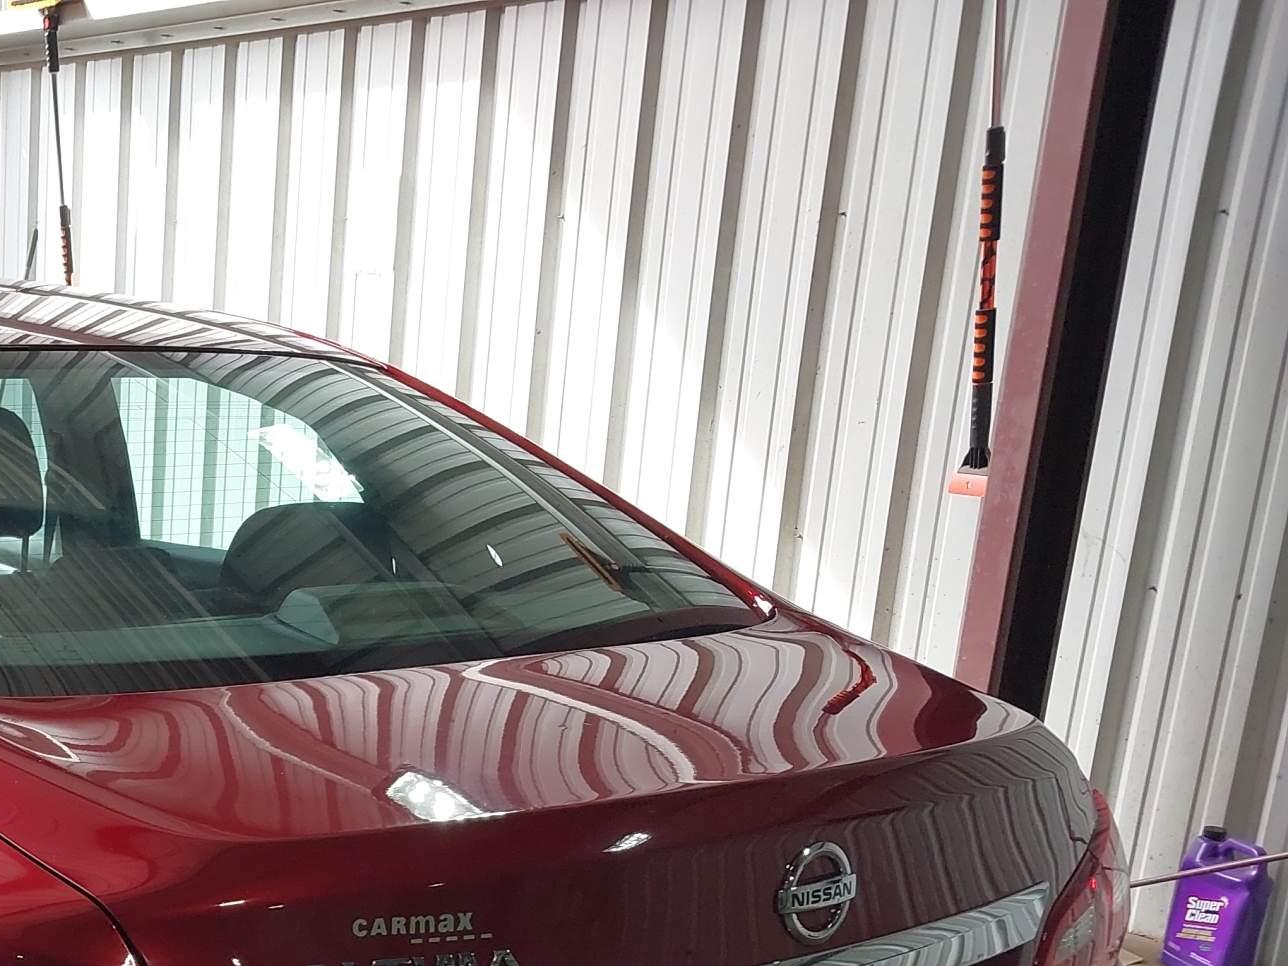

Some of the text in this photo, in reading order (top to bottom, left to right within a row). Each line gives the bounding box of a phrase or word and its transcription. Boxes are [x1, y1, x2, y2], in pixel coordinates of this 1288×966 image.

[791, 881, 852, 908] NISSAN
[1187, 896, 1225, 912] Super
[1184, 909, 1220, 924] Clean
